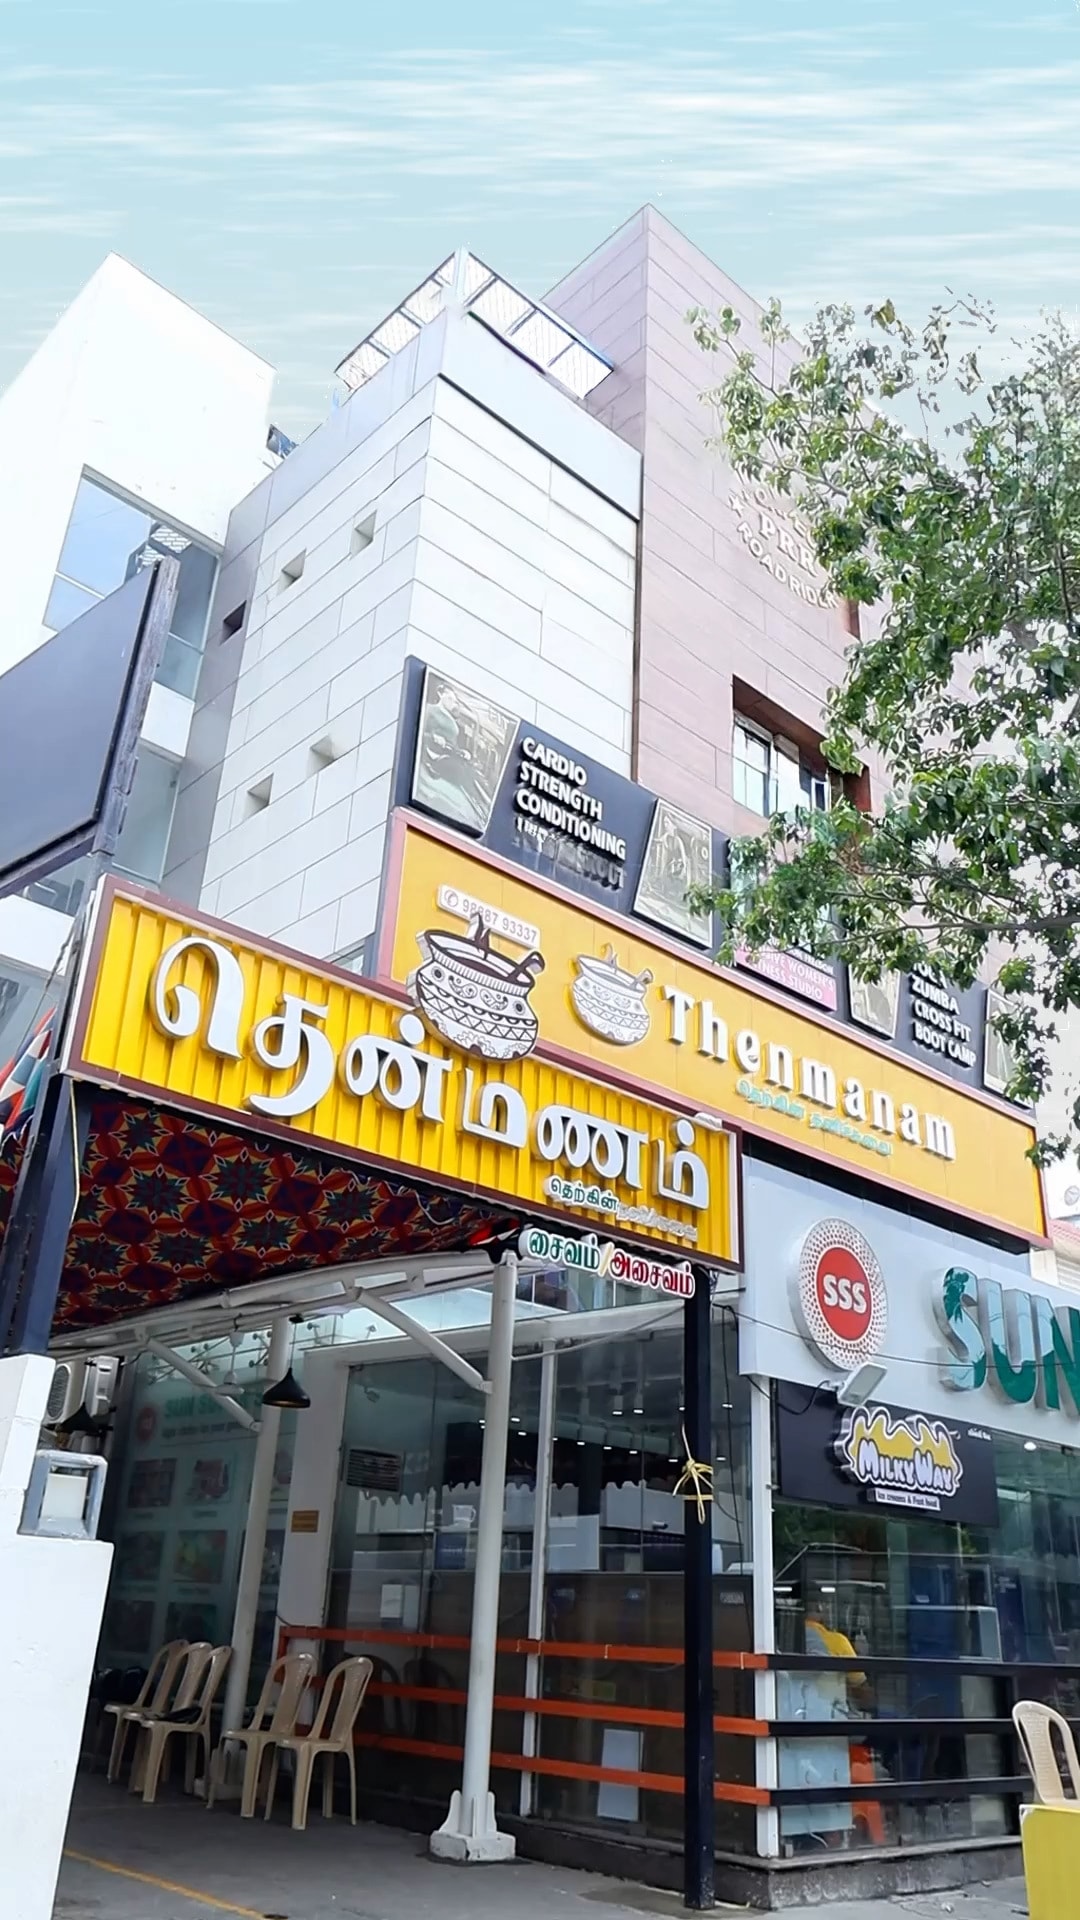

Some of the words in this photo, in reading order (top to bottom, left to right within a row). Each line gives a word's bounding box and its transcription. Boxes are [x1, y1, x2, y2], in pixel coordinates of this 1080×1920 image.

[737, 521, 787, 584] ROAD
[523, 737, 587, 786] CARDIO
[520, 761, 602, 821] STRENGTH
[516, 789, 626, 860] CONDITIONING
[502, 917, 537, 943] 93337
[789, 974, 823, 999] STUDIO
[912, 975, 960, 1015] ZUMBA
[914, 1000, 952, 1033] CROSS
[953, 1020, 971, 1042] FIT
[915, 1022, 946, 1052] BOOT
[948, 1040, 977, 1067] CAMP
[150, 936, 711, 1209] தென்மணம்
[663, 984, 956, 1162] Thenmanam
[551, 1176, 618, 1212] தெற்கின்
[822, 1274, 867, 1315] SSS
[938, 1265, 1080, 1420] SUN
